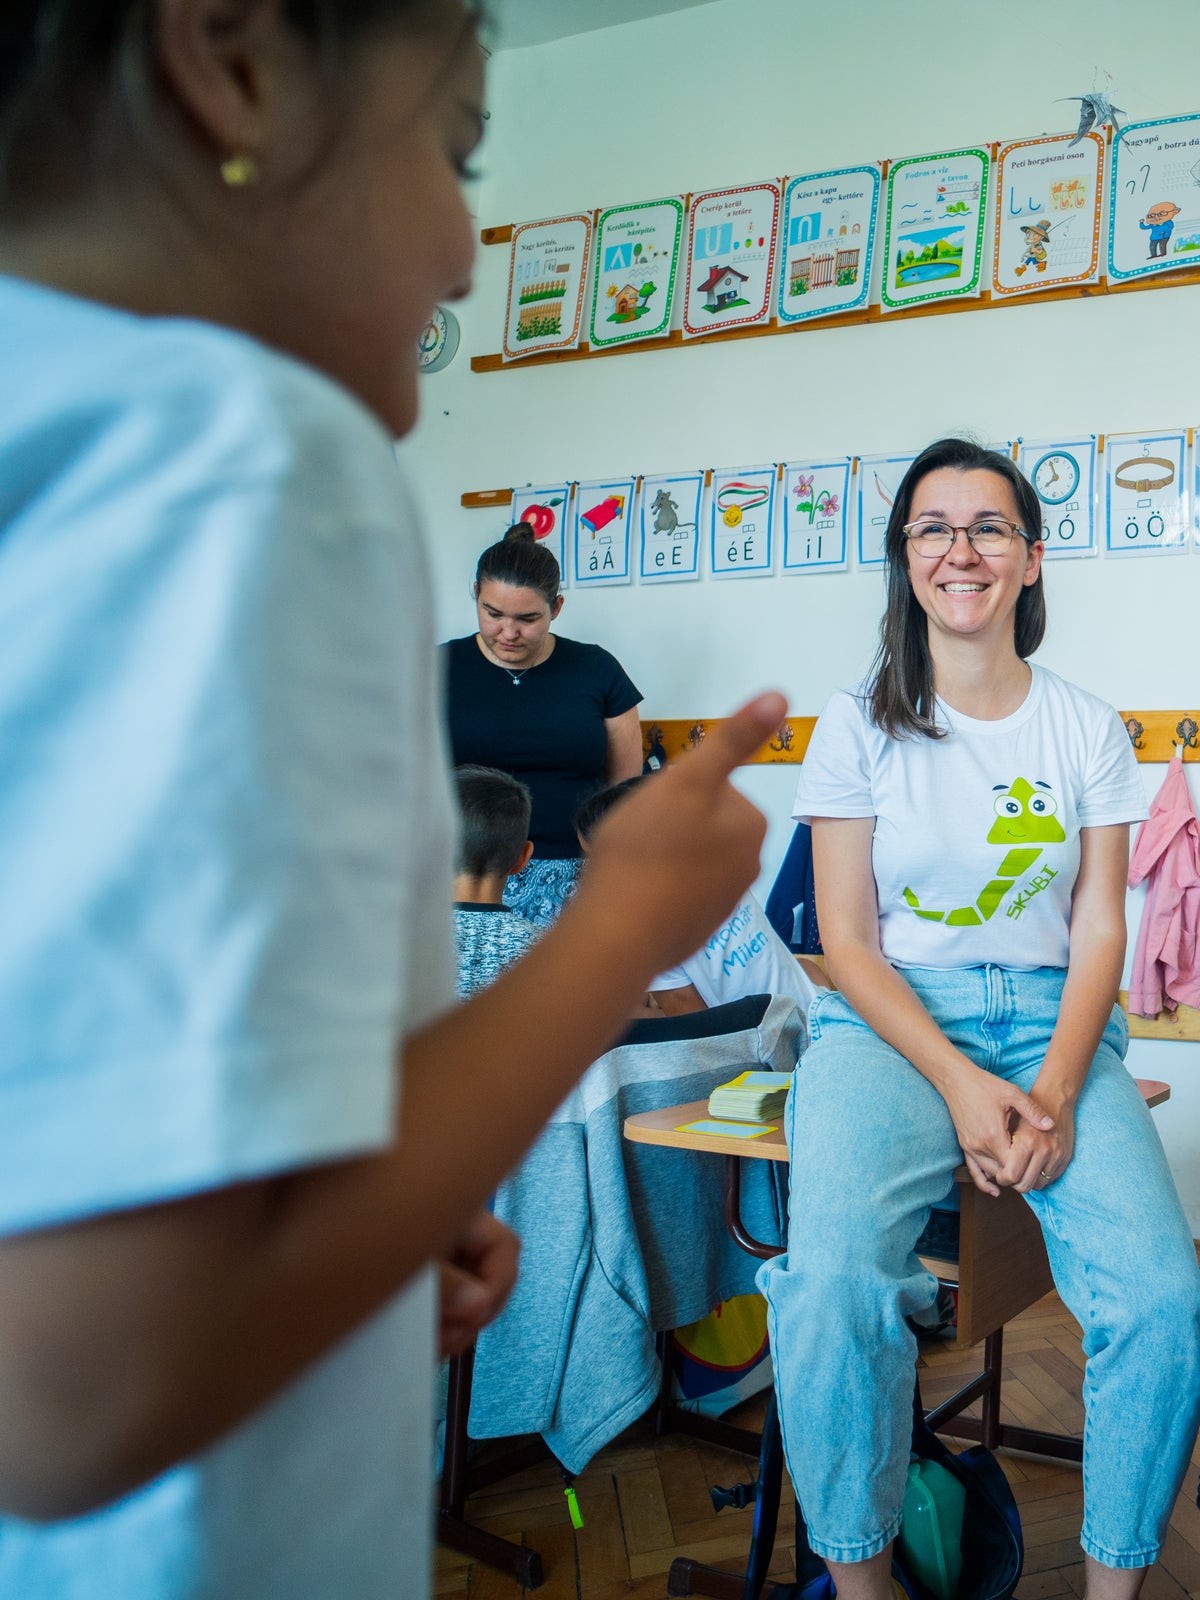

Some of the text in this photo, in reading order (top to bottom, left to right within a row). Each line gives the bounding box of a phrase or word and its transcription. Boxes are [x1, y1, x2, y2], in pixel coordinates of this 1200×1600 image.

[1164, 141, 1187, 150] botra
[1066, 152, 1085, 160] oson
[820, 187, 837, 195] kapu
[1006, 863, 1059, 921] SKUBI
[723, 931, 769, 977] Milán
